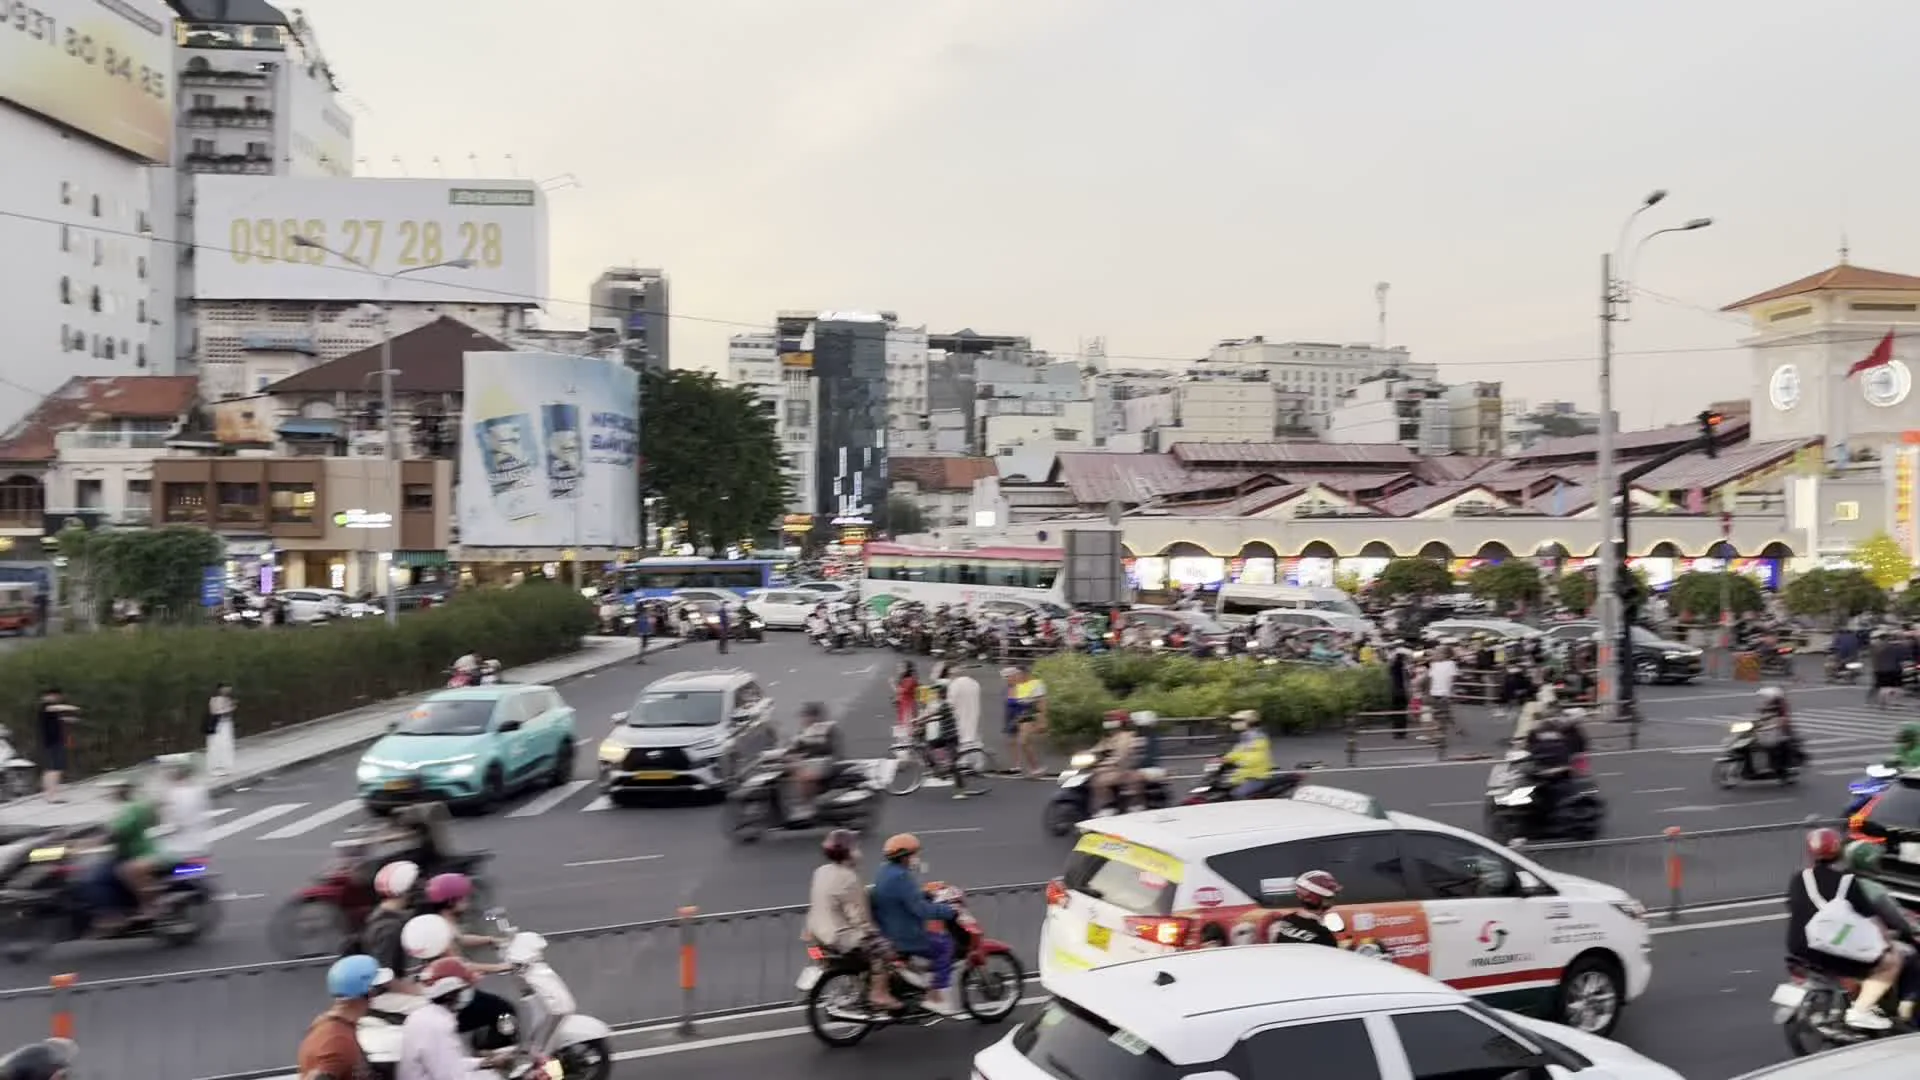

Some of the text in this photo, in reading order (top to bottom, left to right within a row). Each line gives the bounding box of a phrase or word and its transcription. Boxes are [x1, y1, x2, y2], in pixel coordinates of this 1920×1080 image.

[341, 219, 385, 266] 27
[398, 219, 444, 265] 28
[457, 221, 503, 267] 28
